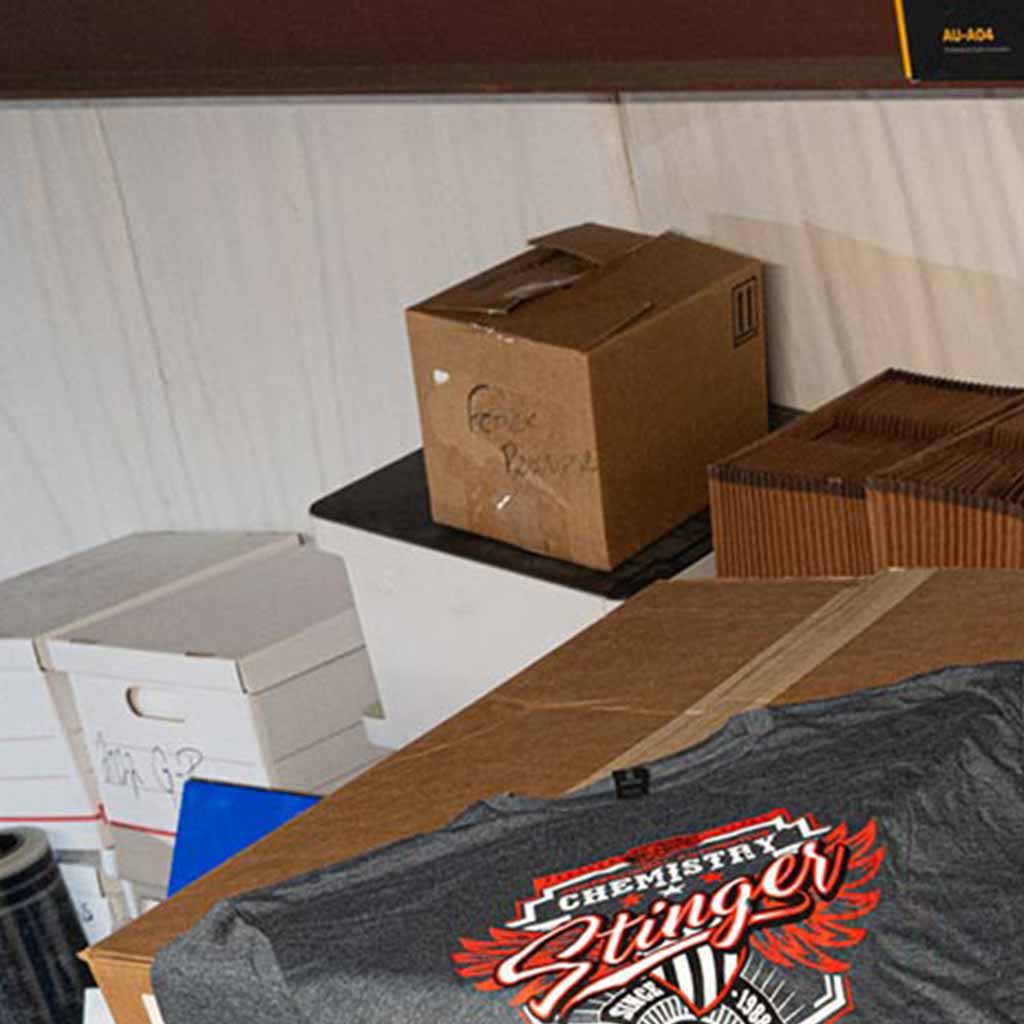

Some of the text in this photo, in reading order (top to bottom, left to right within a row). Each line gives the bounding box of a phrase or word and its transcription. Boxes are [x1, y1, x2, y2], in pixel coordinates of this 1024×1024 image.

[942, 27, 995, 43] AU-A04
[557, 832, 777, 912] CHEMISTRY
[493, 838, 851, 1023] Stinger
